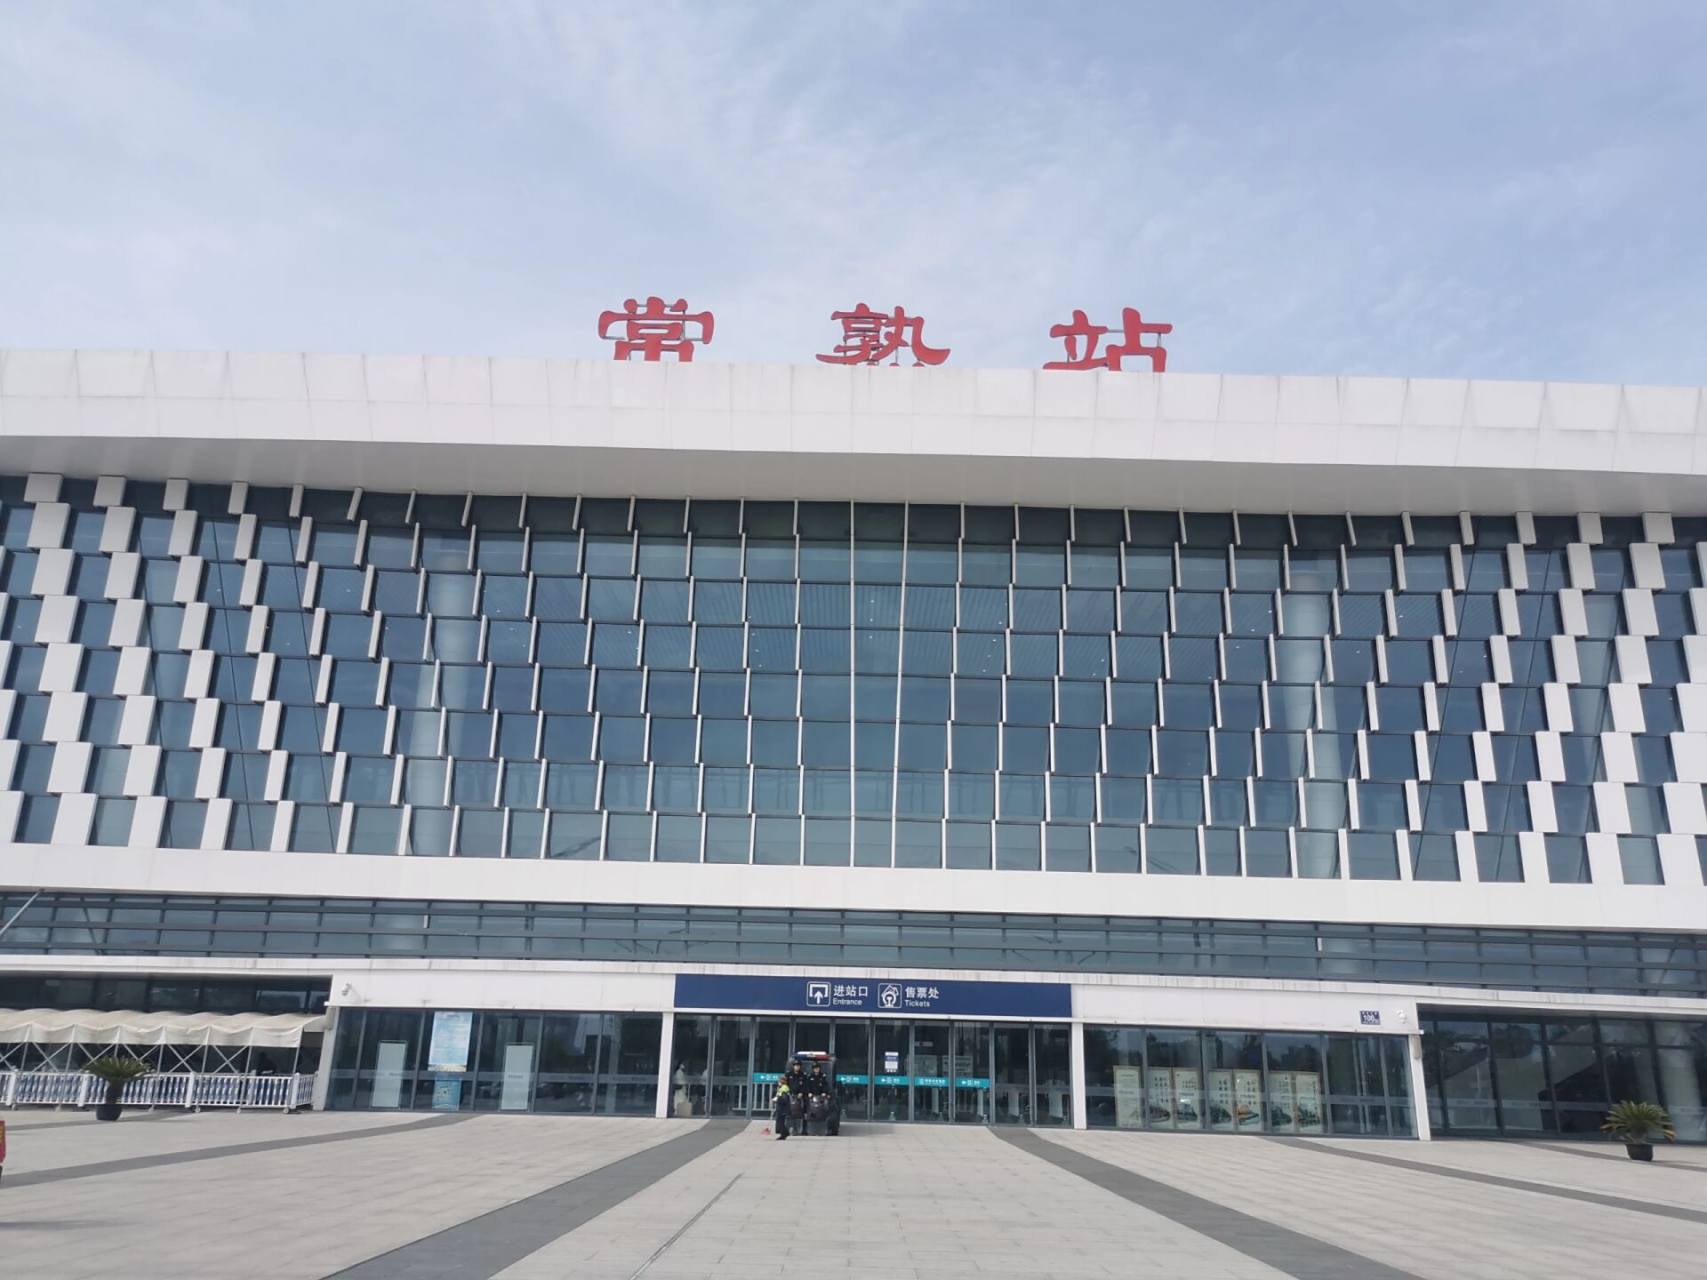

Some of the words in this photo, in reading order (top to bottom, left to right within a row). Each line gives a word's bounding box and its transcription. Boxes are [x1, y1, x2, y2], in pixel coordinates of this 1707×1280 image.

[598, 296, 1172, 372] 常熟站
[833, 985, 869, 998] 进站口
[905, 987, 940, 999] 售票处
[833, 998, 863, 1006] Entrance
[905, 1000, 931, 1008] Tickets
